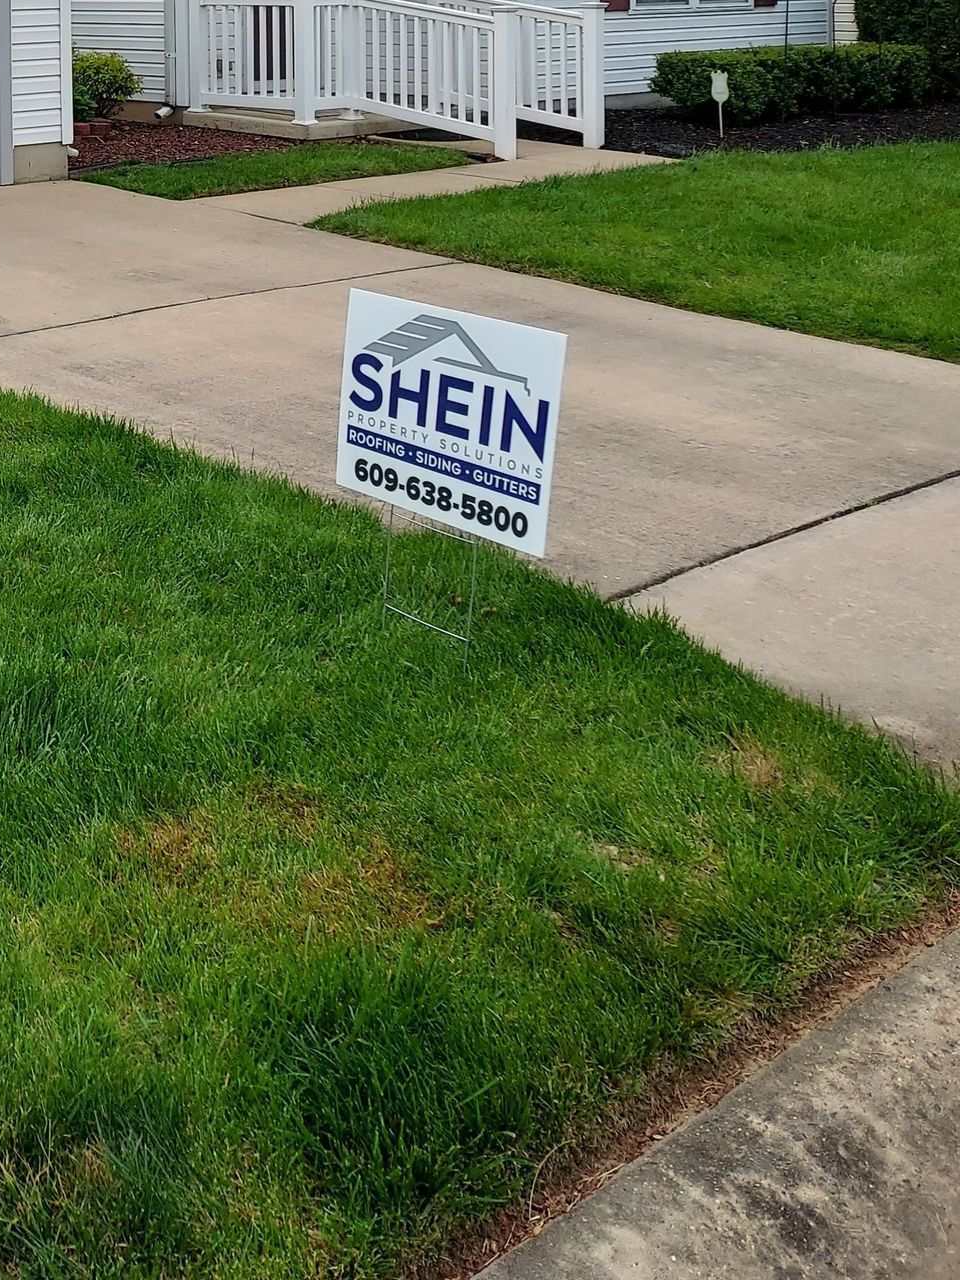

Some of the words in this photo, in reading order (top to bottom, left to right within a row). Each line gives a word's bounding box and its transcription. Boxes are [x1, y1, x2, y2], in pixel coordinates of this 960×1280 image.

[347, 410, 429, 444] PROPERTY
[440, 438, 543, 479] SOLUTIONS
[348, 352, 550, 464] SHEIN
[348, 430, 406, 458] ROOFING
[415, 450, 462, 475] SIDING
[472, 468, 537, 501] GUTTERS
[354, 458, 528, 538] 609-638-5800
